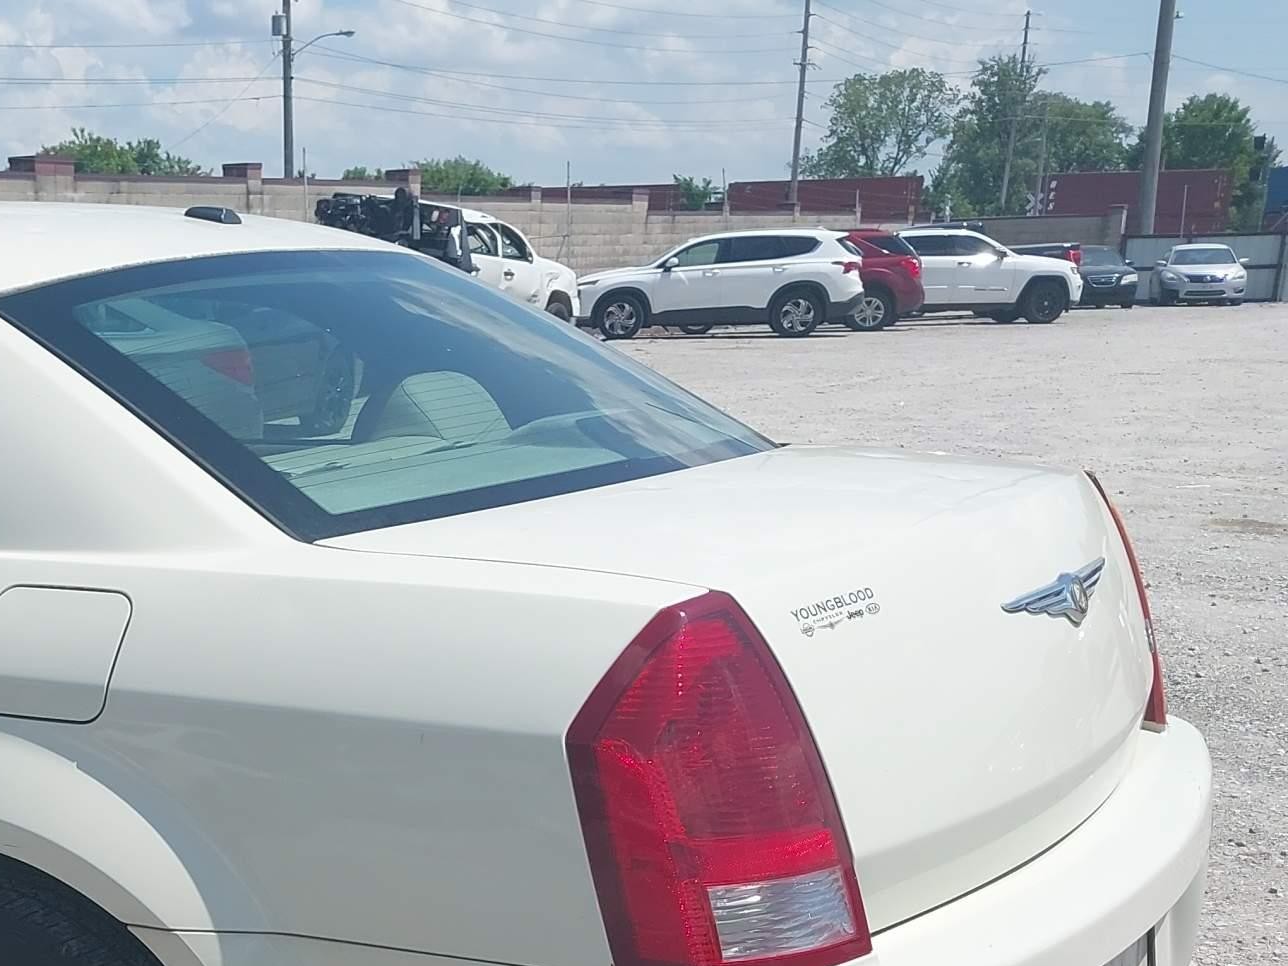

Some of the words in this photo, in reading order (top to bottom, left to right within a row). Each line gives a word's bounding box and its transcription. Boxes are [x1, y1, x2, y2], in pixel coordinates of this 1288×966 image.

[790, 587, 874, 622] YOUNGBLOOD
[846, 608, 864, 620] Jeep
[867, 604, 879, 613] KIA
